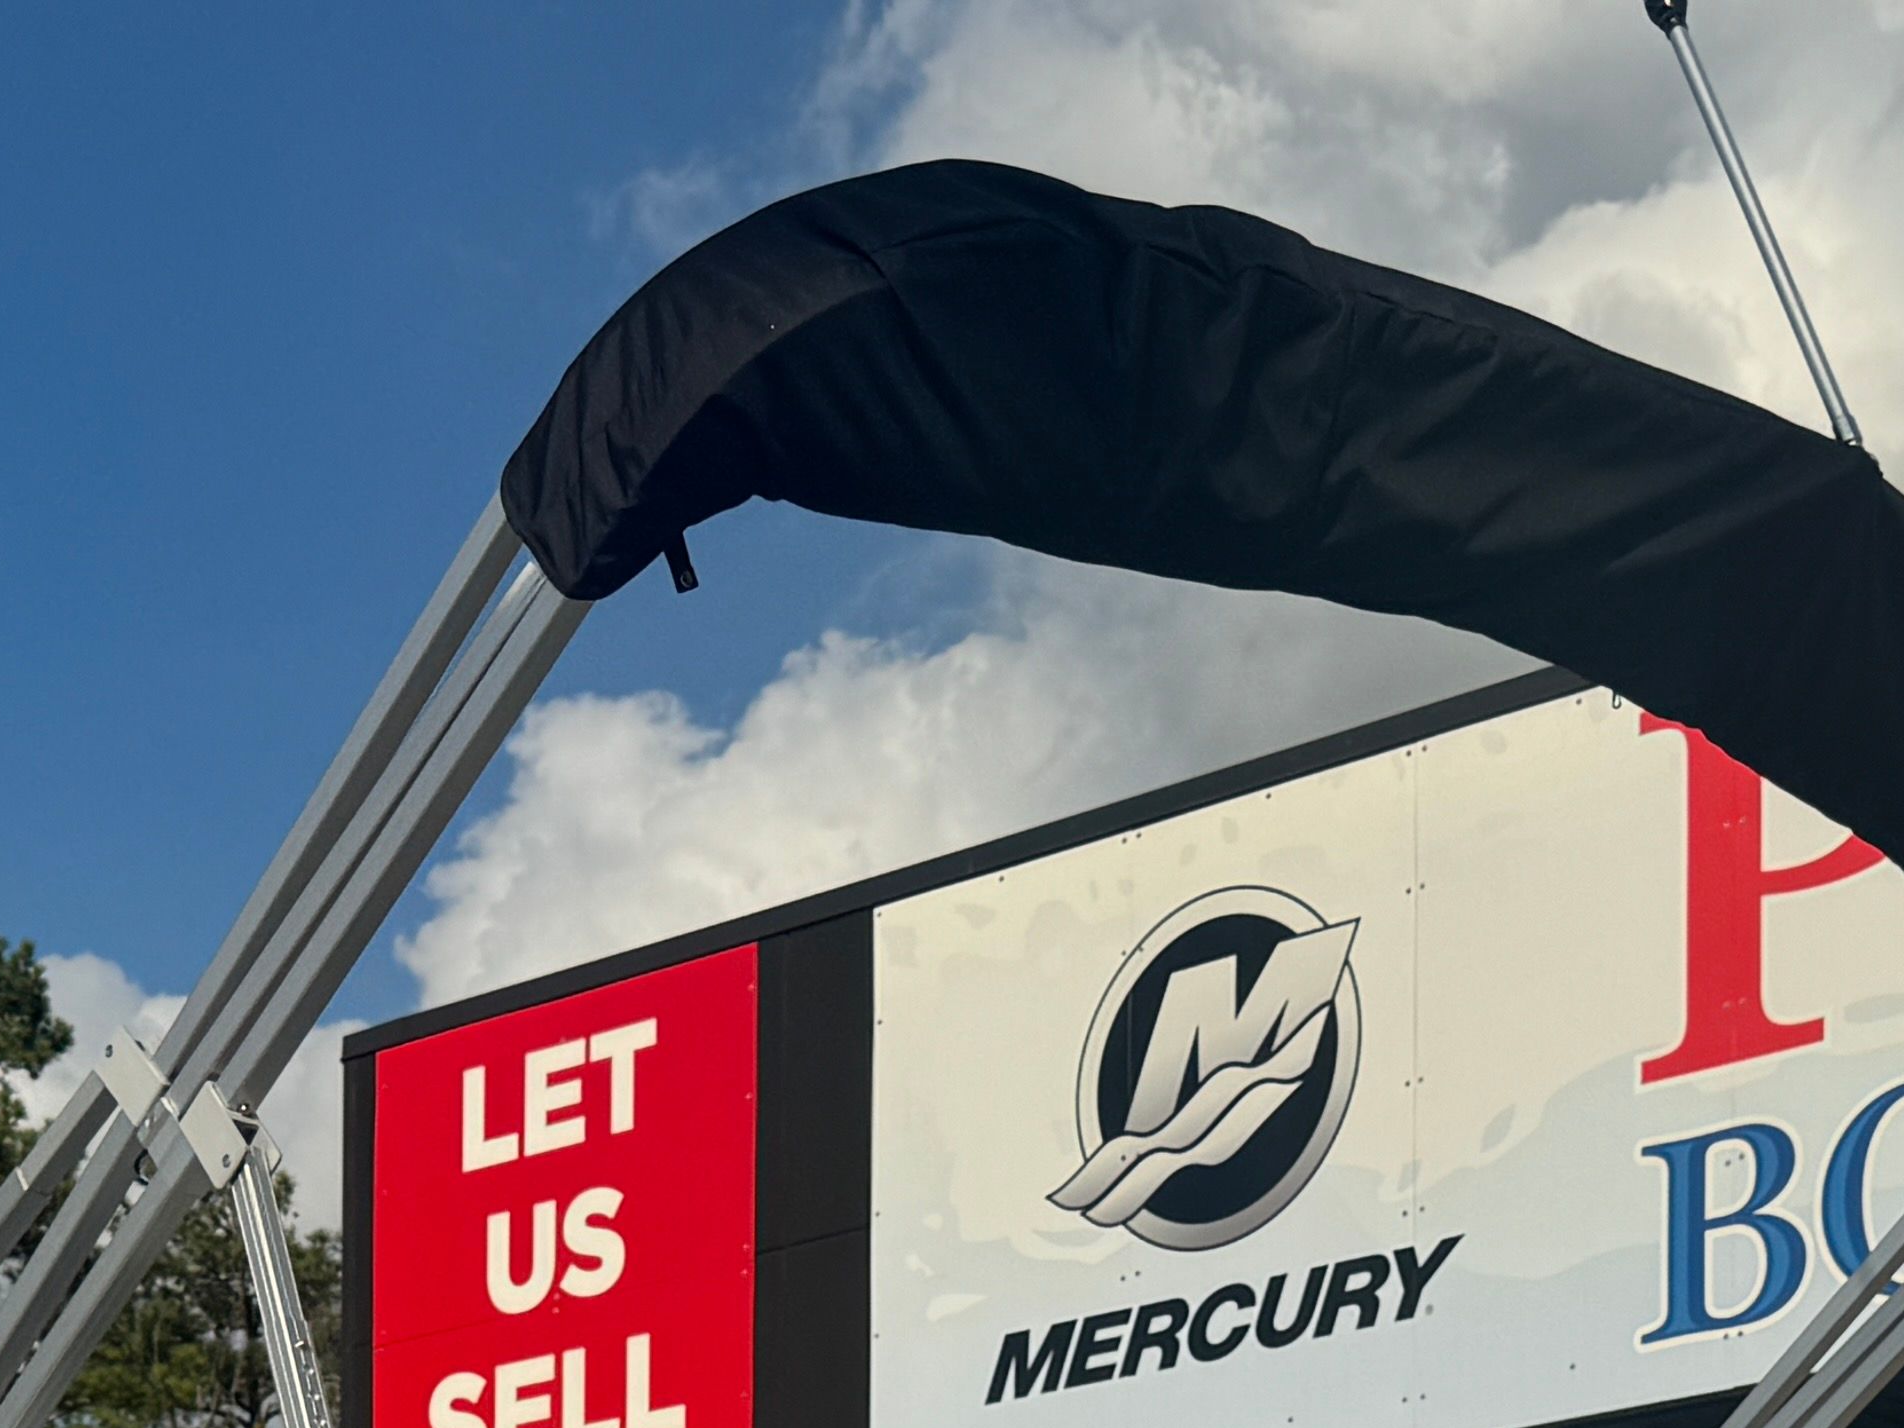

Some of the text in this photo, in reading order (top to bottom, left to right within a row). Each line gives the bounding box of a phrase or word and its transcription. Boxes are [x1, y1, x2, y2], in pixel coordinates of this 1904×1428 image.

[462, 1017, 657, 1173] LET
[486, 1186, 626, 1314] US
[984, 1234, 1466, 1405] MERCURY
